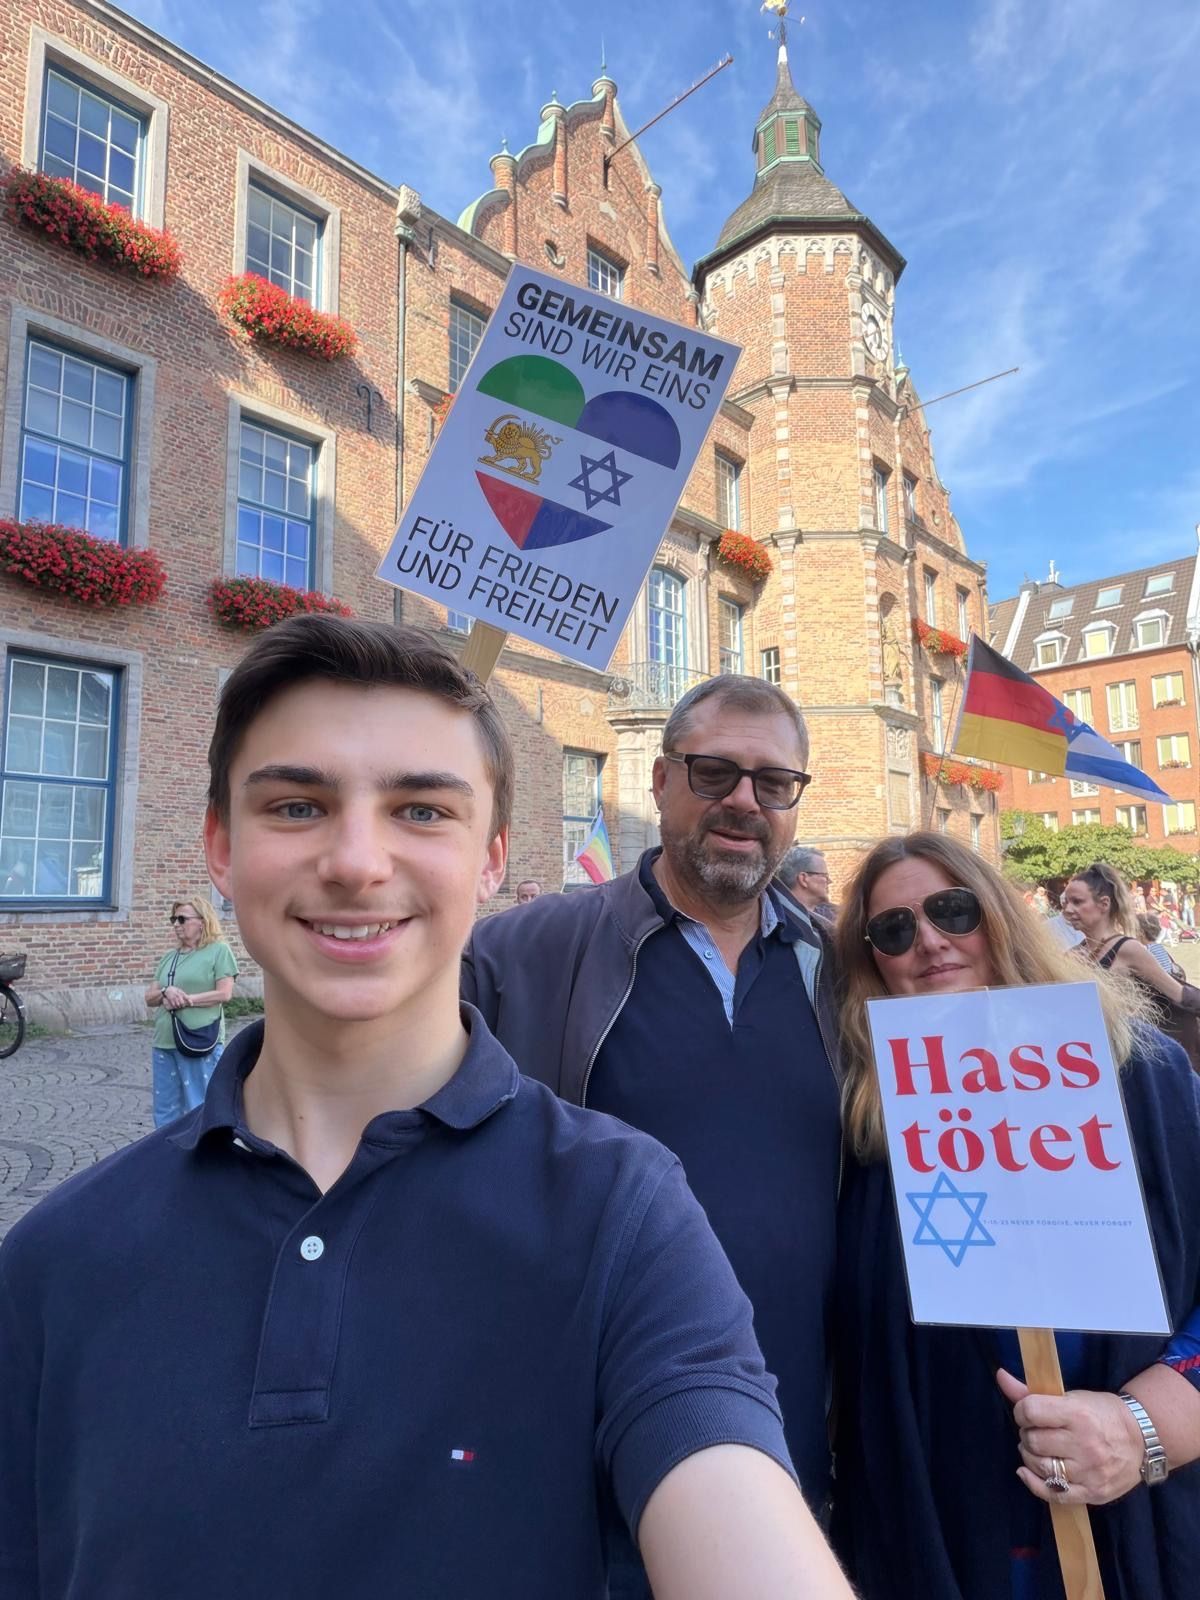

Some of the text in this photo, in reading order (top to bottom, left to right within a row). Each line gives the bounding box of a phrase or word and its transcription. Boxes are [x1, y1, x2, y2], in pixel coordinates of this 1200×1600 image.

[504, 311, 712, 411] SIND WIR EINS
[517, 282, 725, 381] GEMEINSAM
[397, 544, 607, 651] UND FREIHEIT
[408, 515, 620, 623] FÜR FRIEDEN
[887, 1035, 1101, 1096] Hass
[900, 1108, 1122, 1174] tötet
